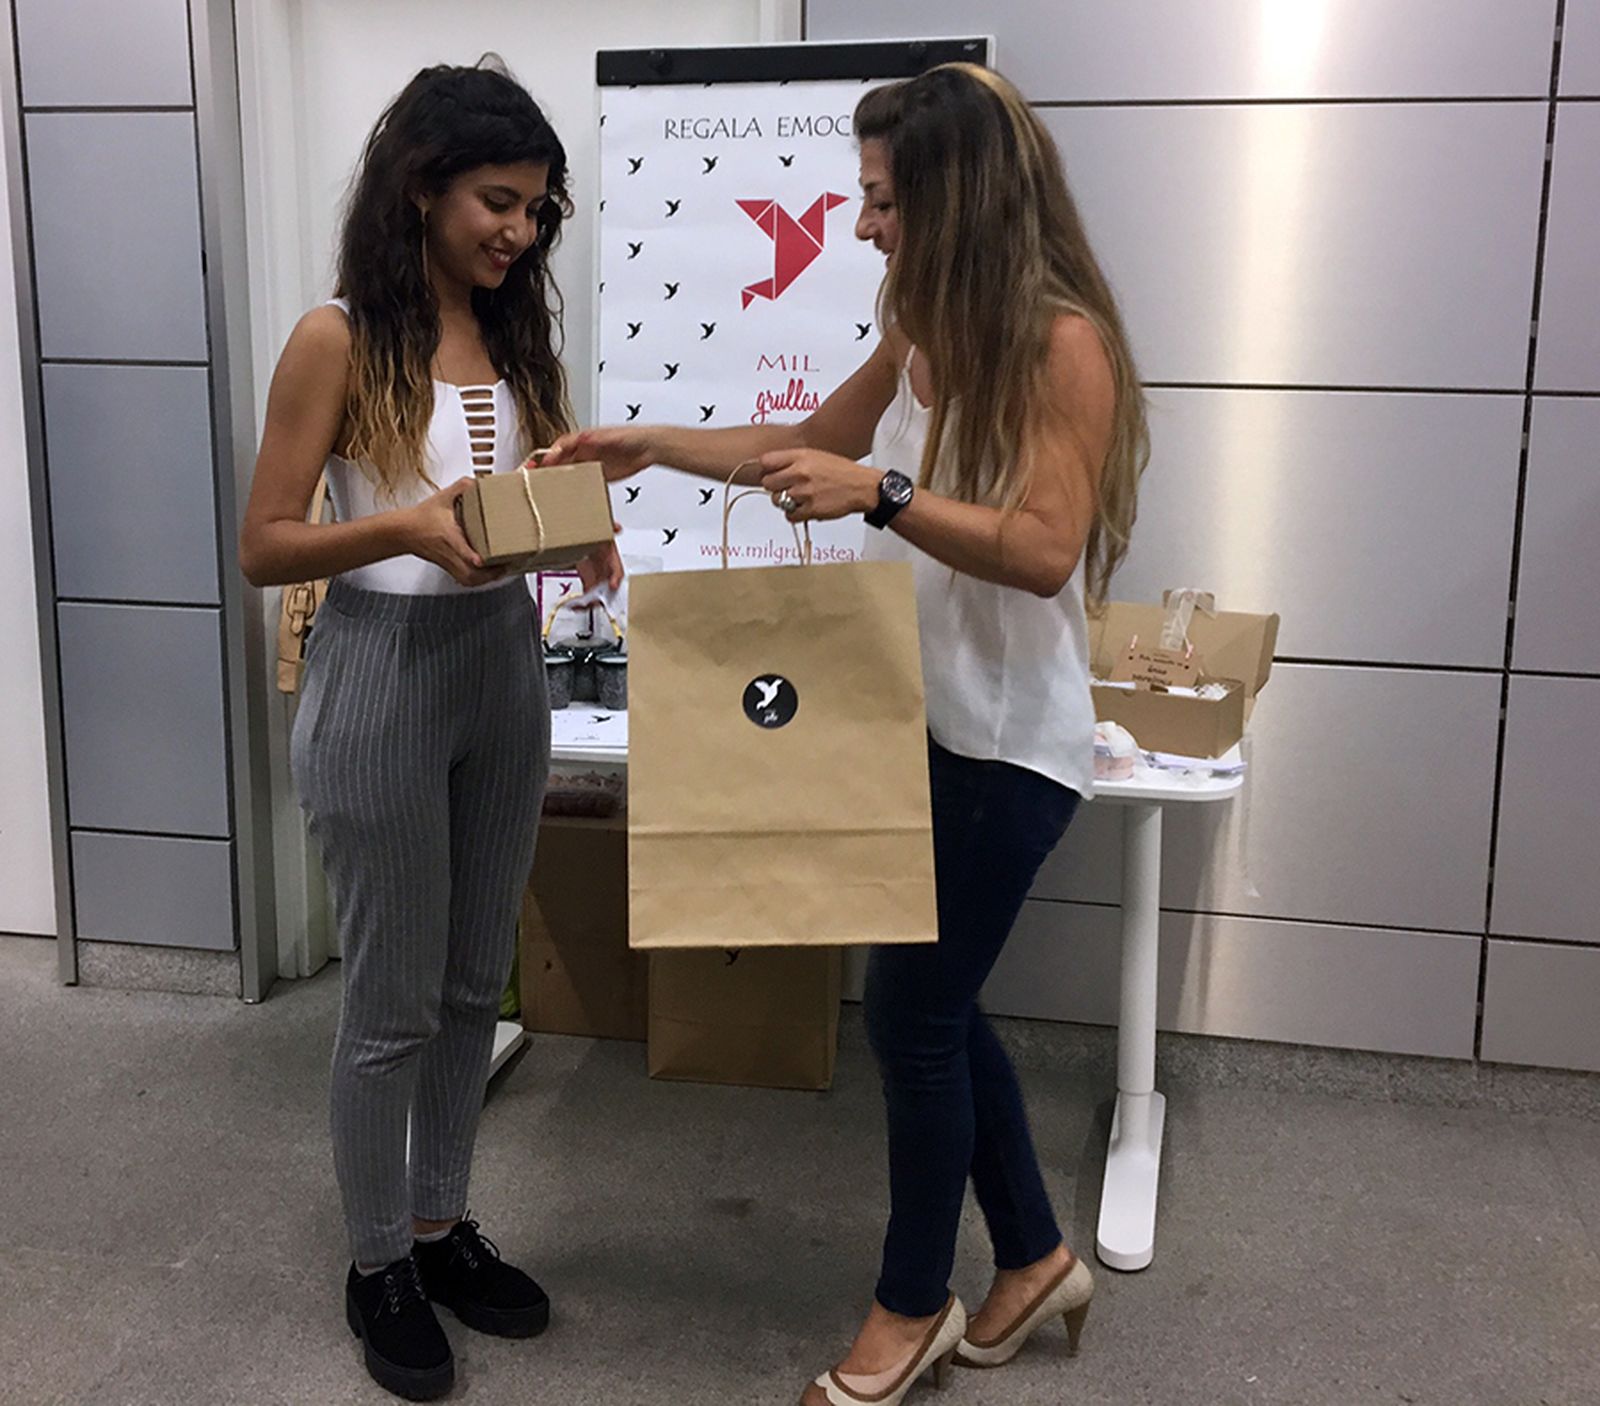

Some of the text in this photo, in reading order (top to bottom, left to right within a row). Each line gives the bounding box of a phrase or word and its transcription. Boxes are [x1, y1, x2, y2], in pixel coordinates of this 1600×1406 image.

[664, 114, 851, 140] REGALA EMOC
[757, 354, 820, 372] MIL
[750, 377, 819, 426] grullas
